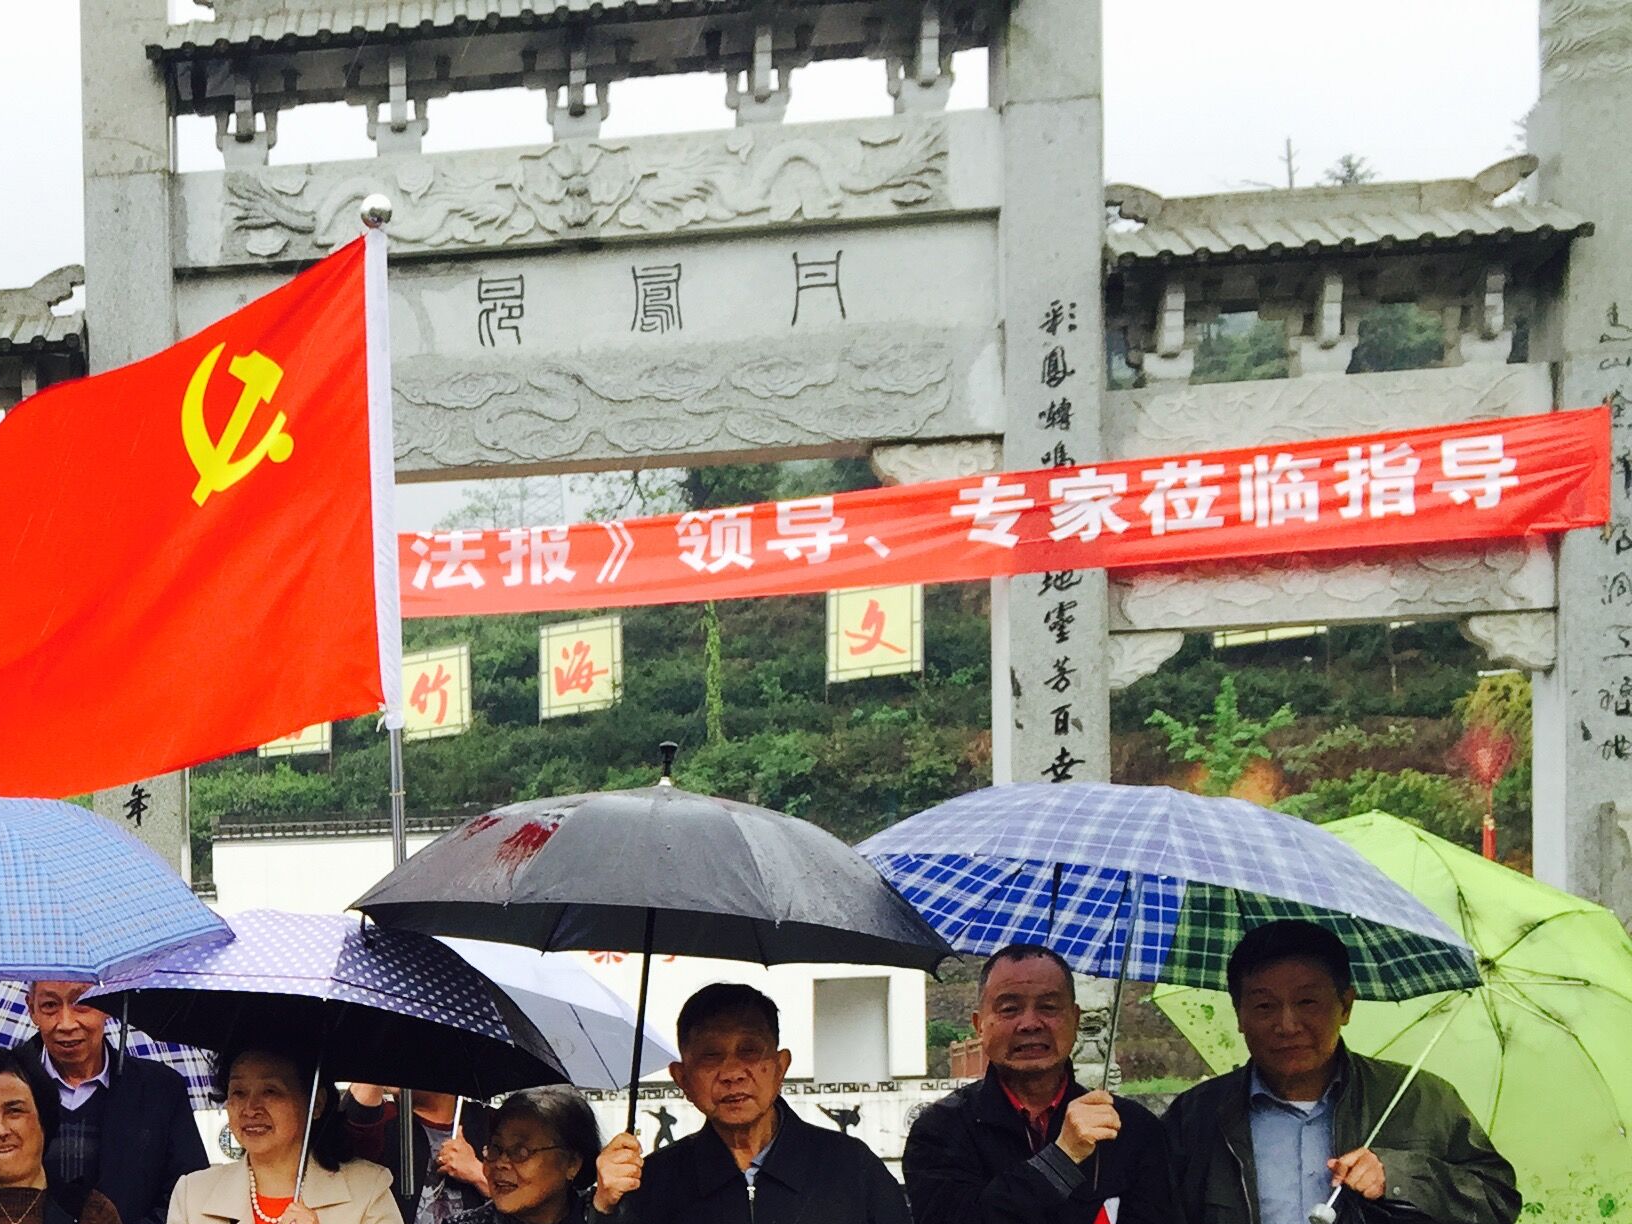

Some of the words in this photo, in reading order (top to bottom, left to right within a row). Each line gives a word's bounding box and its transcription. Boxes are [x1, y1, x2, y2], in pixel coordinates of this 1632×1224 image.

[844, 598, 908, 657] 文
[410, 664, 451, 726] 竹
[553, 640, 609, 697] 海
